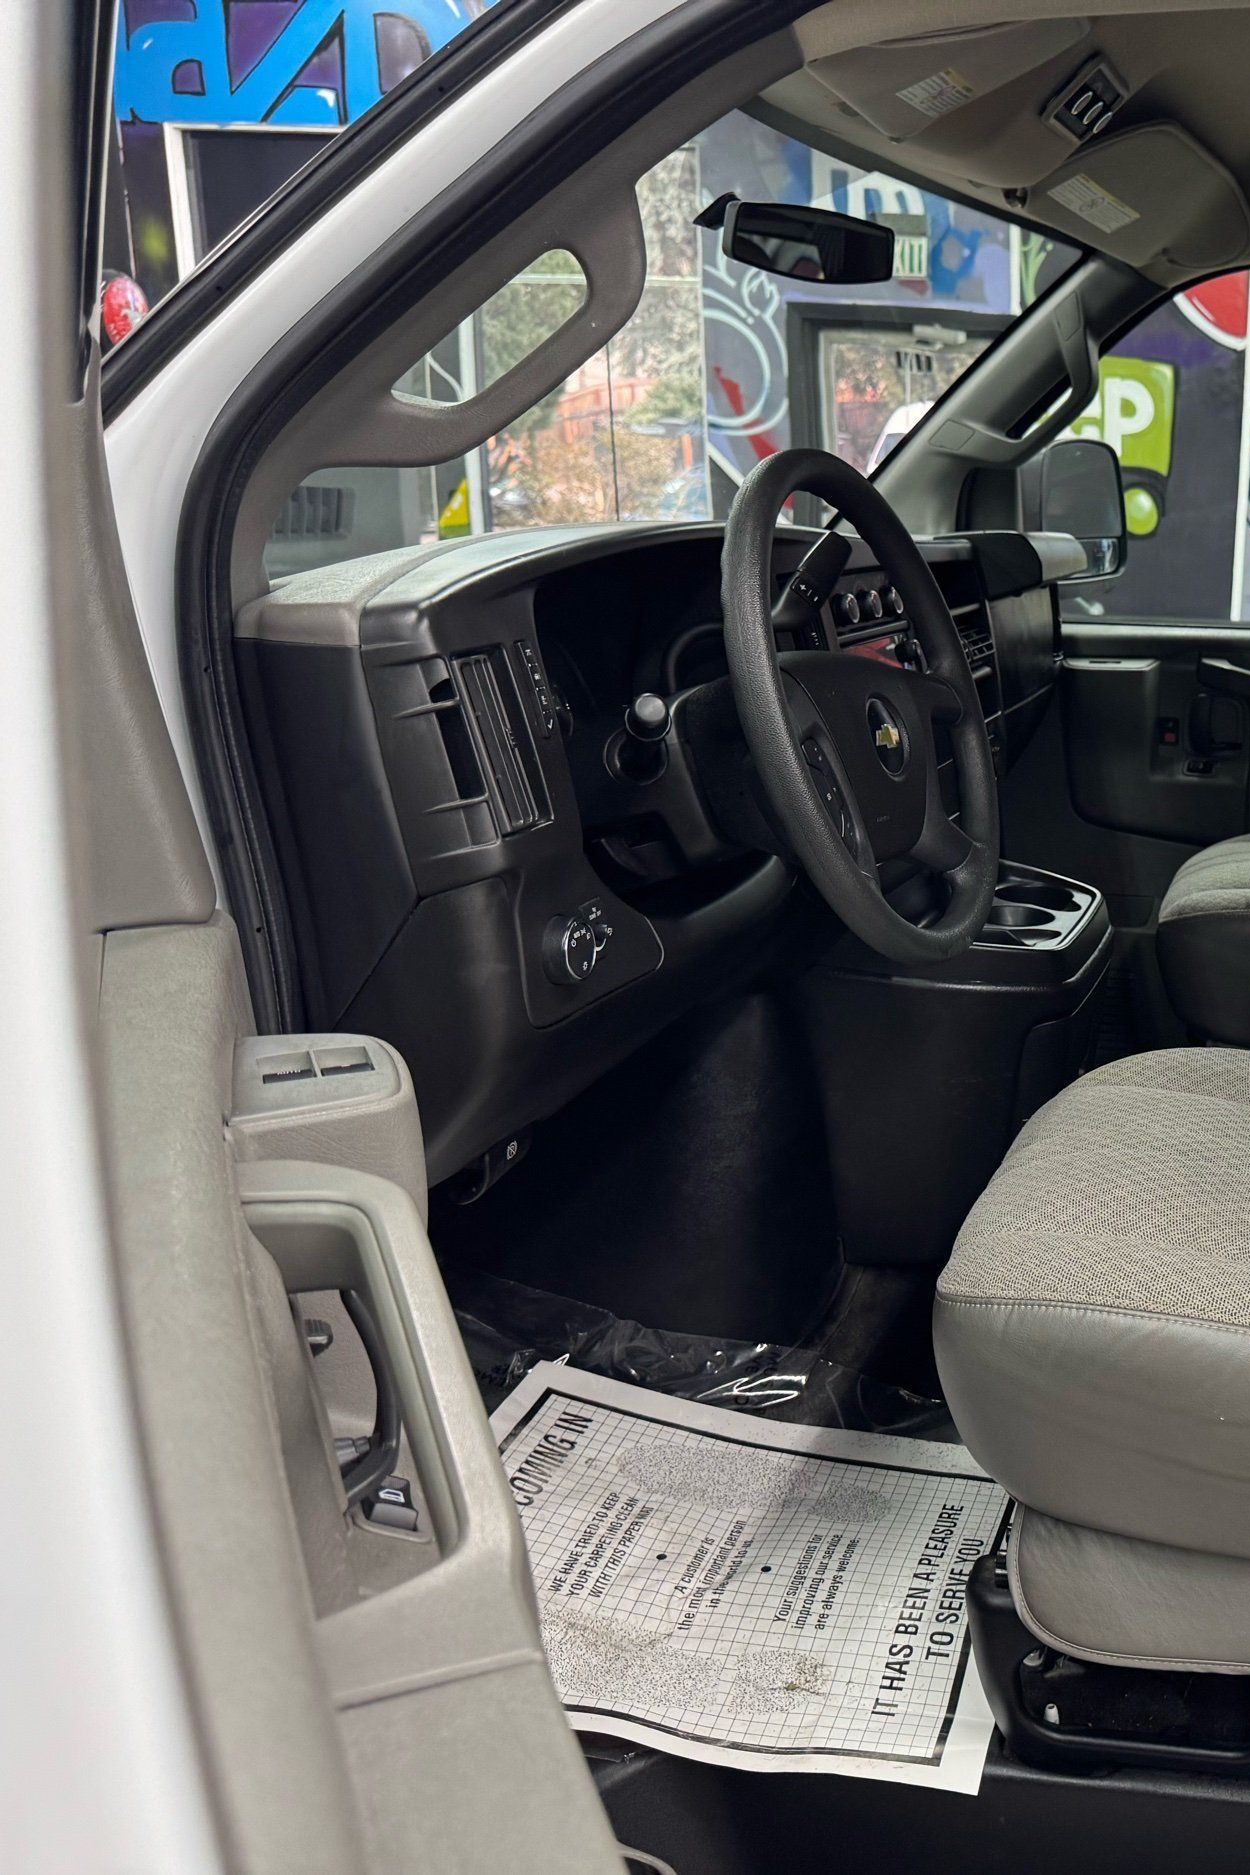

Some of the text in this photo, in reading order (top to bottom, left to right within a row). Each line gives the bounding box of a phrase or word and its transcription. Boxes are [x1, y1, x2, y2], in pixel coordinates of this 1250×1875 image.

[510, 1411, 594, 1506] COMING IN
[548, 1492, 620, 1592] WE HAVE TRIED TO KEEP
[566, 1496, 640, 1596] YOUR CARPETING CLEAN
[588, 1571, 612, 1598] WITH
[604, 1548, 627, 1571] THIS
[618, 1519, 644, 1548] PAPER
[674, 1536, 715, 1594] A customer is
[677, 1612, 695, 1631] the
[699, 1547, 730, 1585] important
[724, 1520, 747, 1547] person
[734, 1550, 748, 1559] to
[773, 1534, 824, 1622] Your suggestions for
[791, 1533, 843, 1630] improving our service
[706, 1598, 720, 1608] in
[712, 1580, 729, 1595] the
[814, 1612, 830, 1630] are
[821, 1574, 844, 1610] always
[871, 1503, 965, 1717] IT HAS BEEN A PLEASURE
[925, 1538, 985, 1660] TO SERVE YOU
